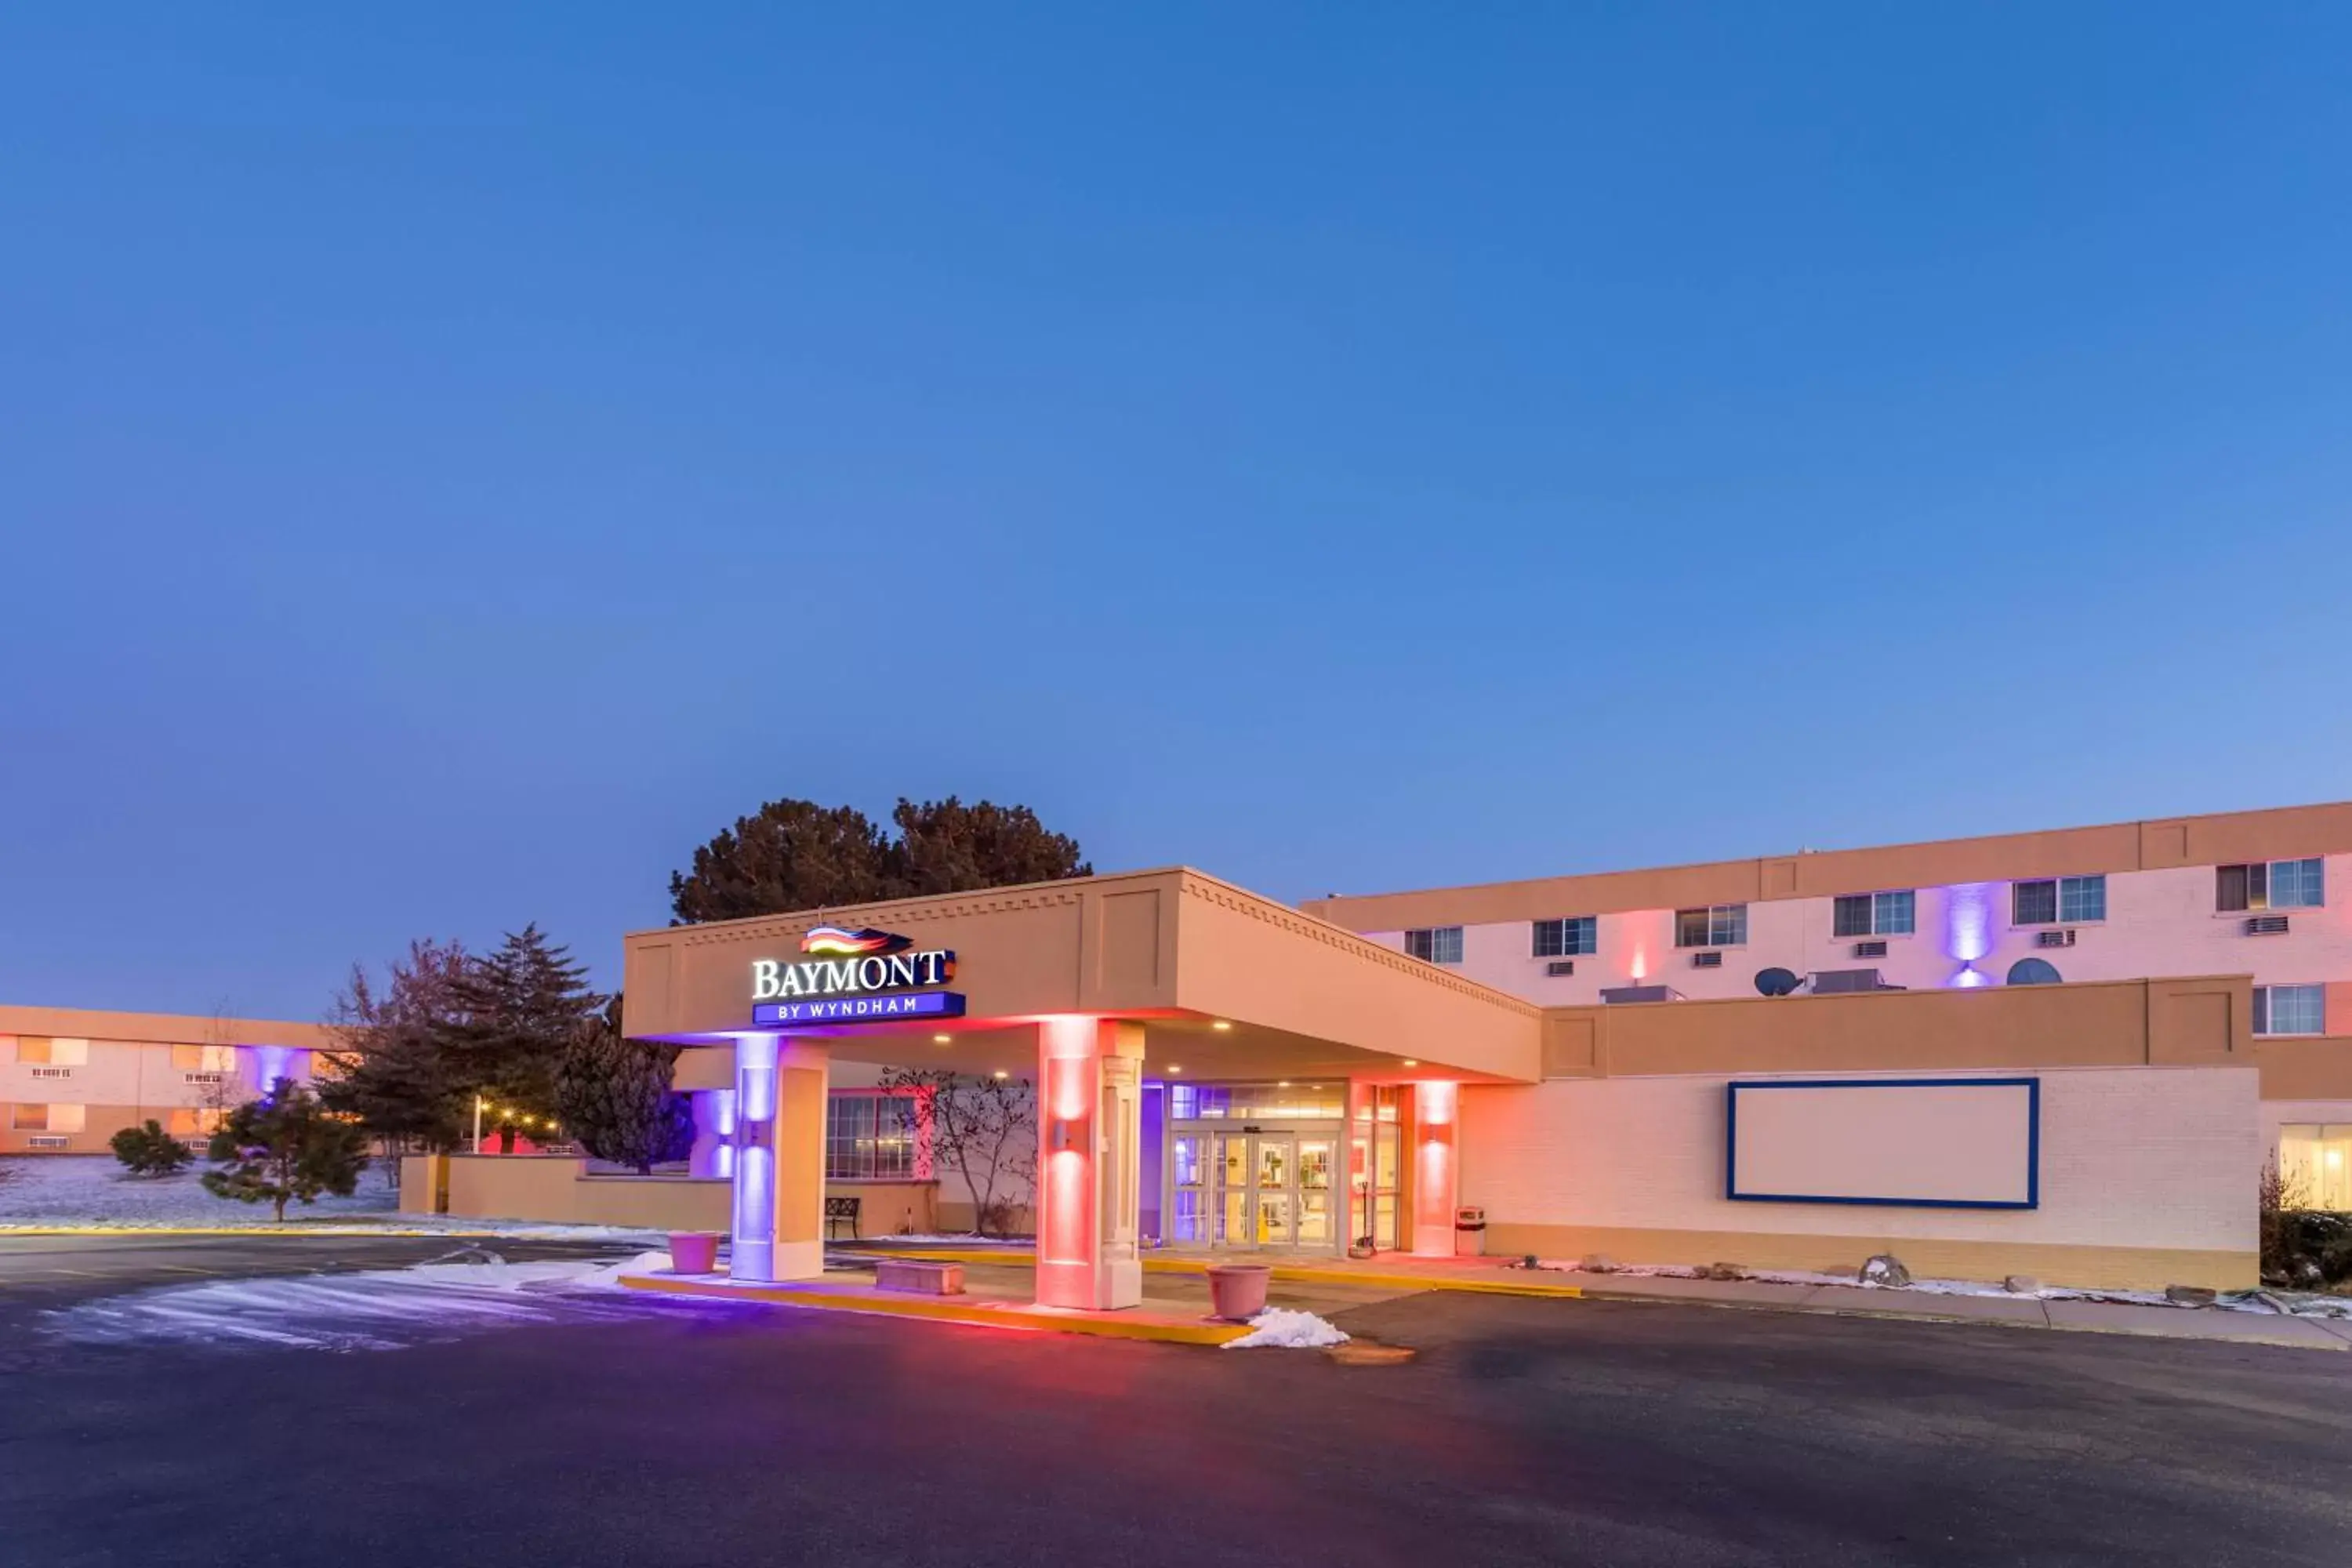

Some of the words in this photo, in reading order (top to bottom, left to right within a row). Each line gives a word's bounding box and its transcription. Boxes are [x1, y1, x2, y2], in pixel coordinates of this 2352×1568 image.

[753, 950, 947, 999] BAYMONT
[778, 1004, 800, 1019] BY
[810, 997, 916, 1017] WYNDHAM
